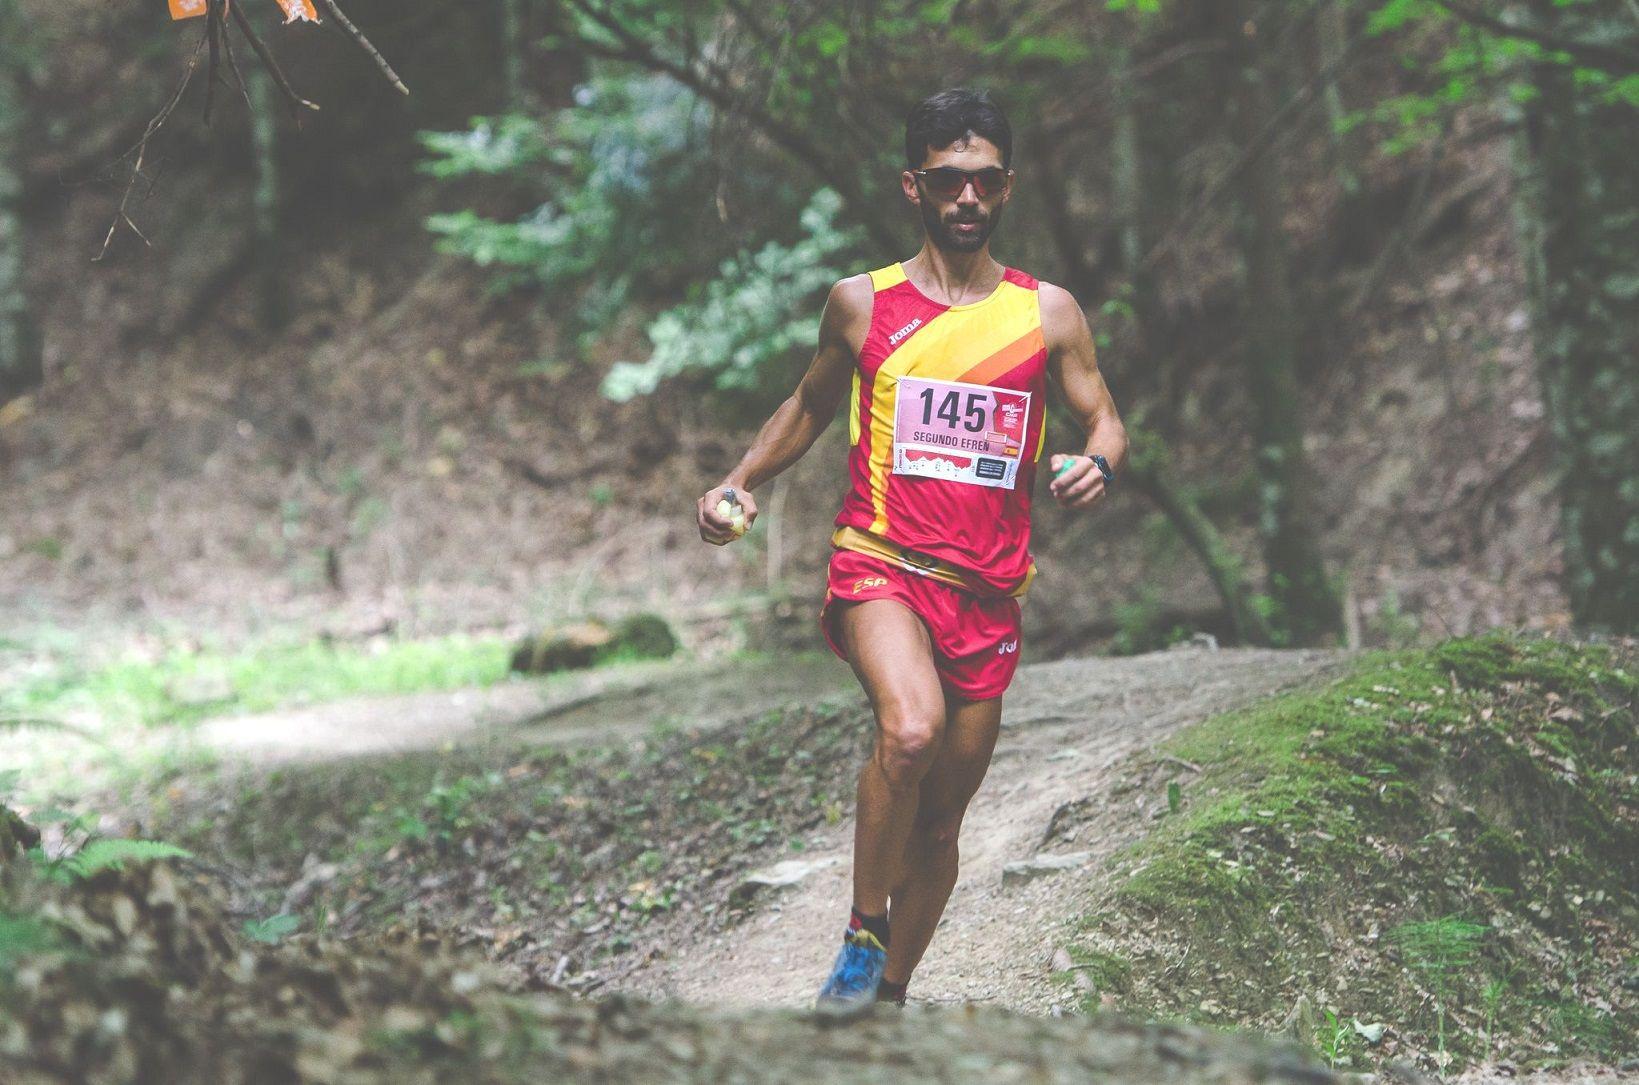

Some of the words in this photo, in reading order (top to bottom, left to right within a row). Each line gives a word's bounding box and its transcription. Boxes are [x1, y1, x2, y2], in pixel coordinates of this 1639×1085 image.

[920, 387, 987, 432] 145
[913, 431, 958, 447] SEGUNDO
[961, 438, 990, 452] EFREN
[852, 577, 888, 594] ESP
